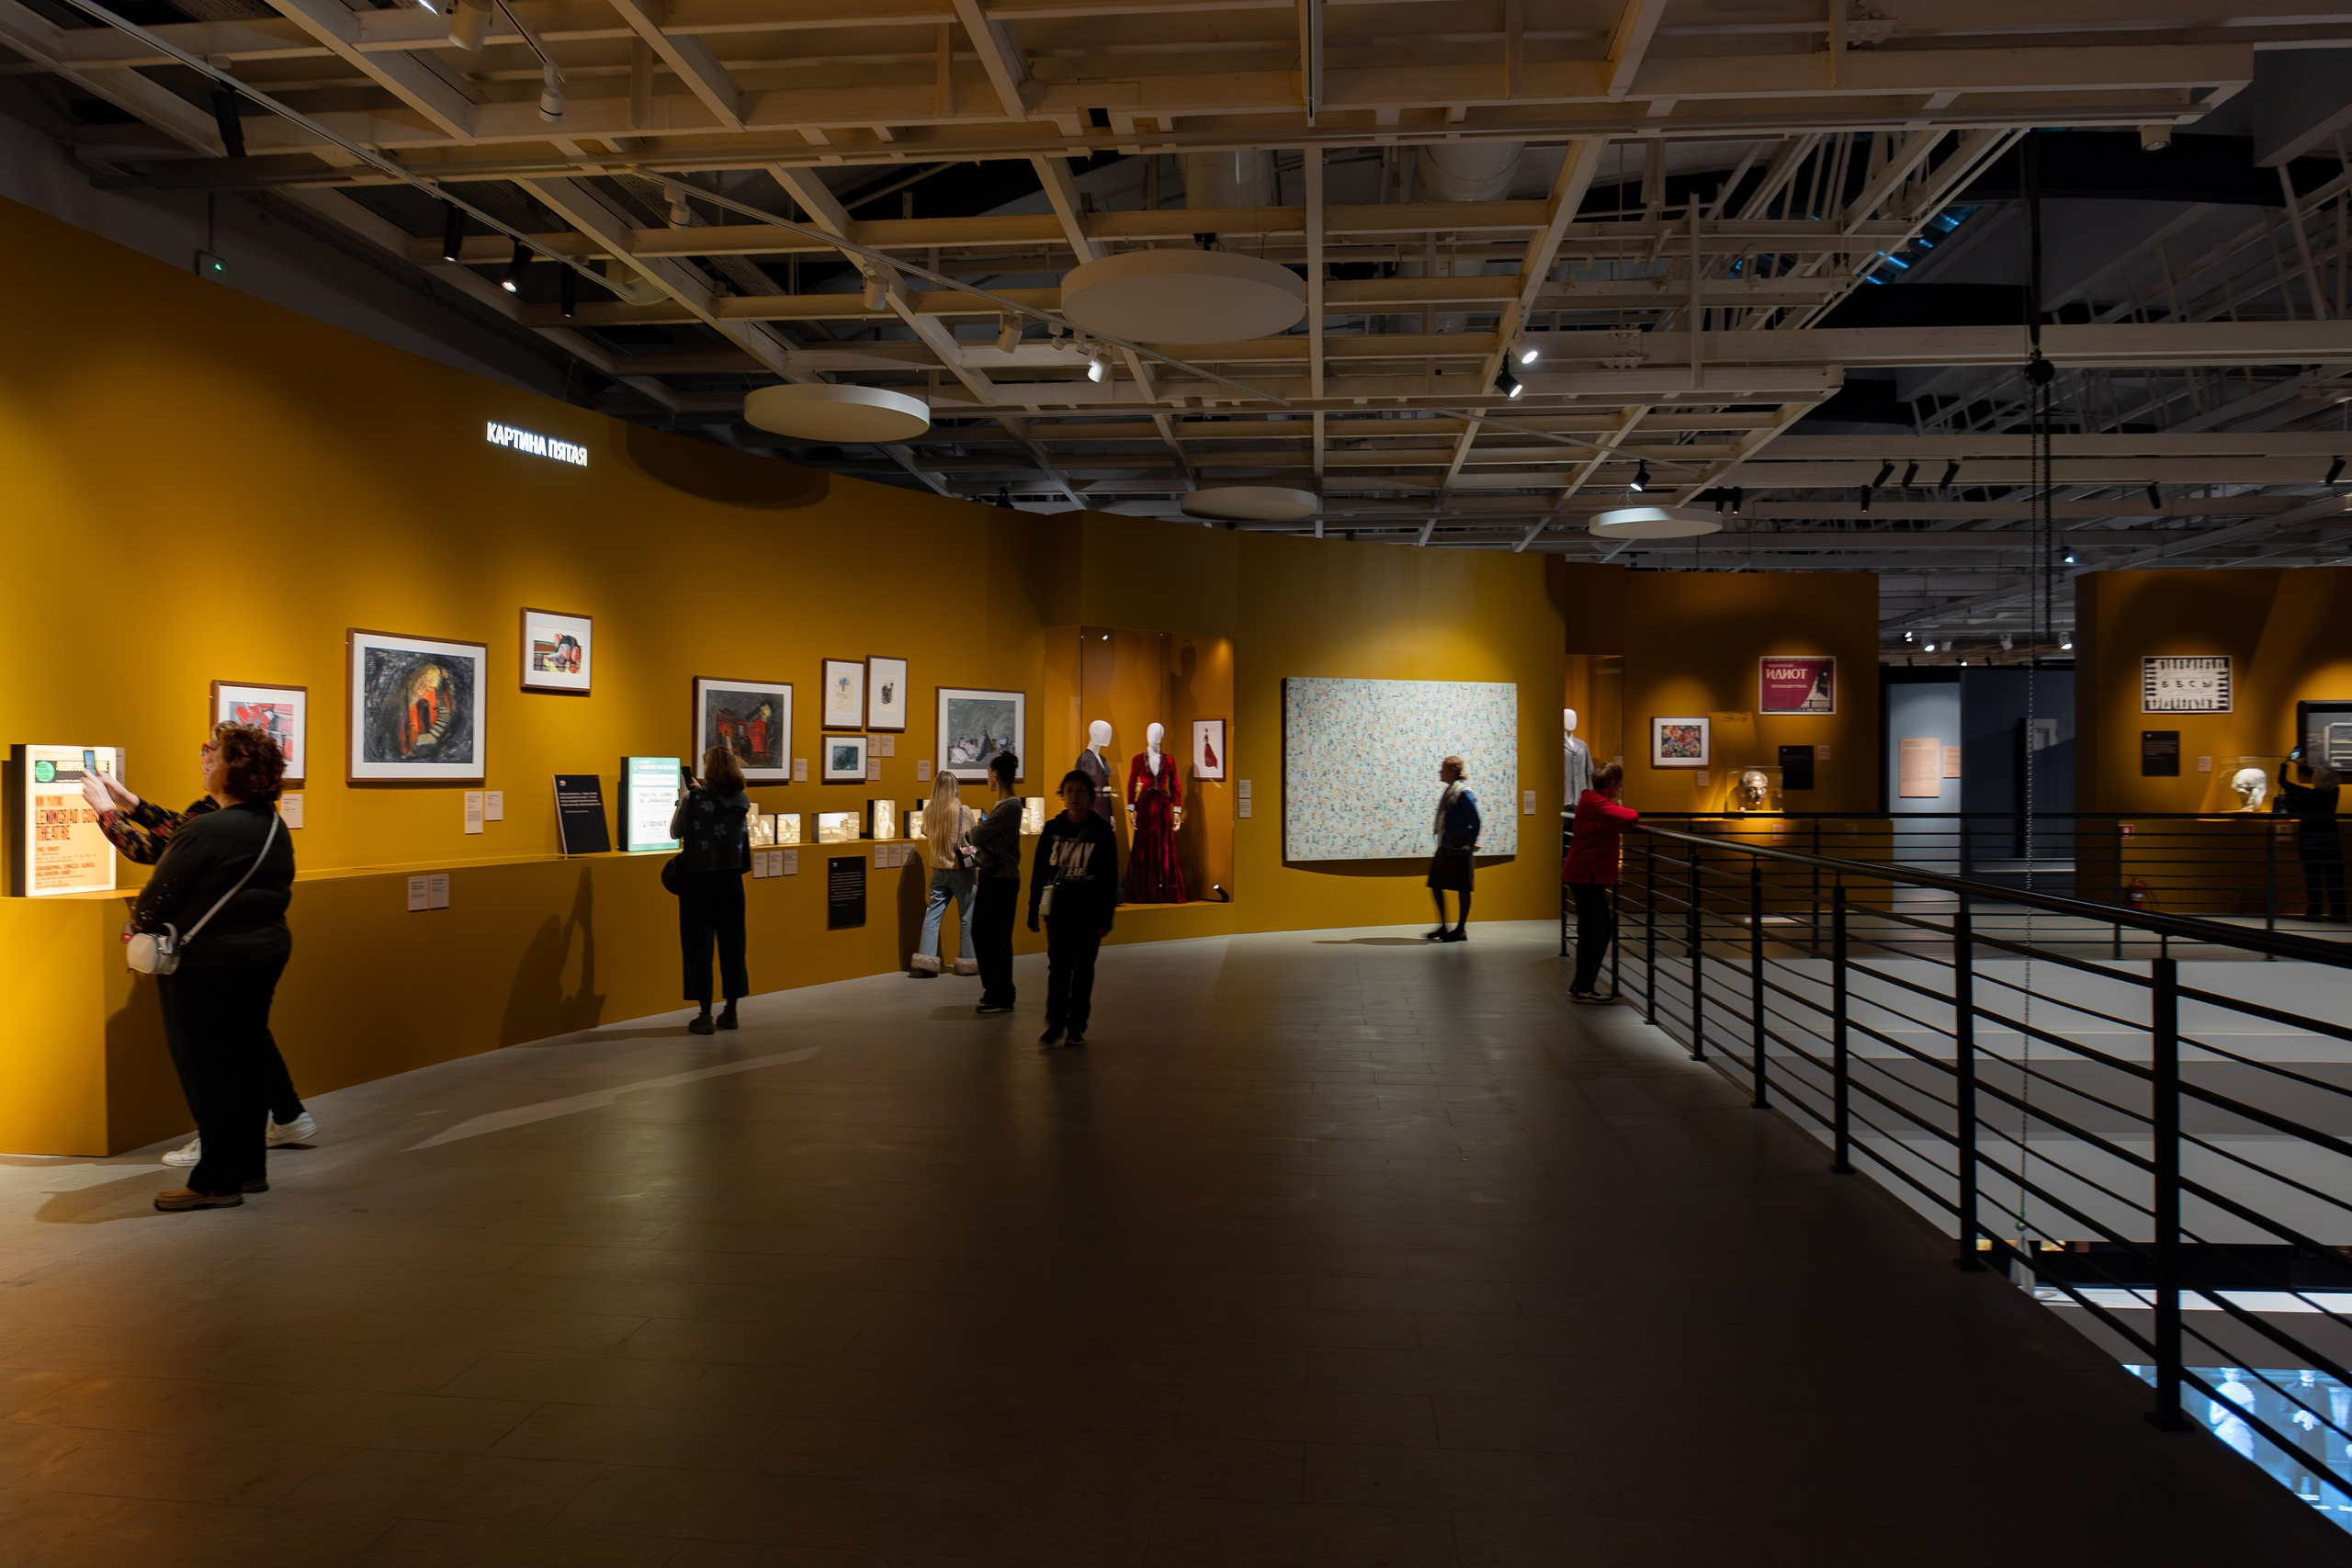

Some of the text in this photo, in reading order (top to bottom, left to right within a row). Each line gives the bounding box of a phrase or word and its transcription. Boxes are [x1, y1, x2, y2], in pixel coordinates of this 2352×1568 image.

[486, 422, 588, 468] КАРТИНА ПЯТАЯ
[1765, 668, 1808, 680] ИДИОТ
[36, 809, 78, 825] LENINGRAD
[36, 825, 71, 841] THEATRE
